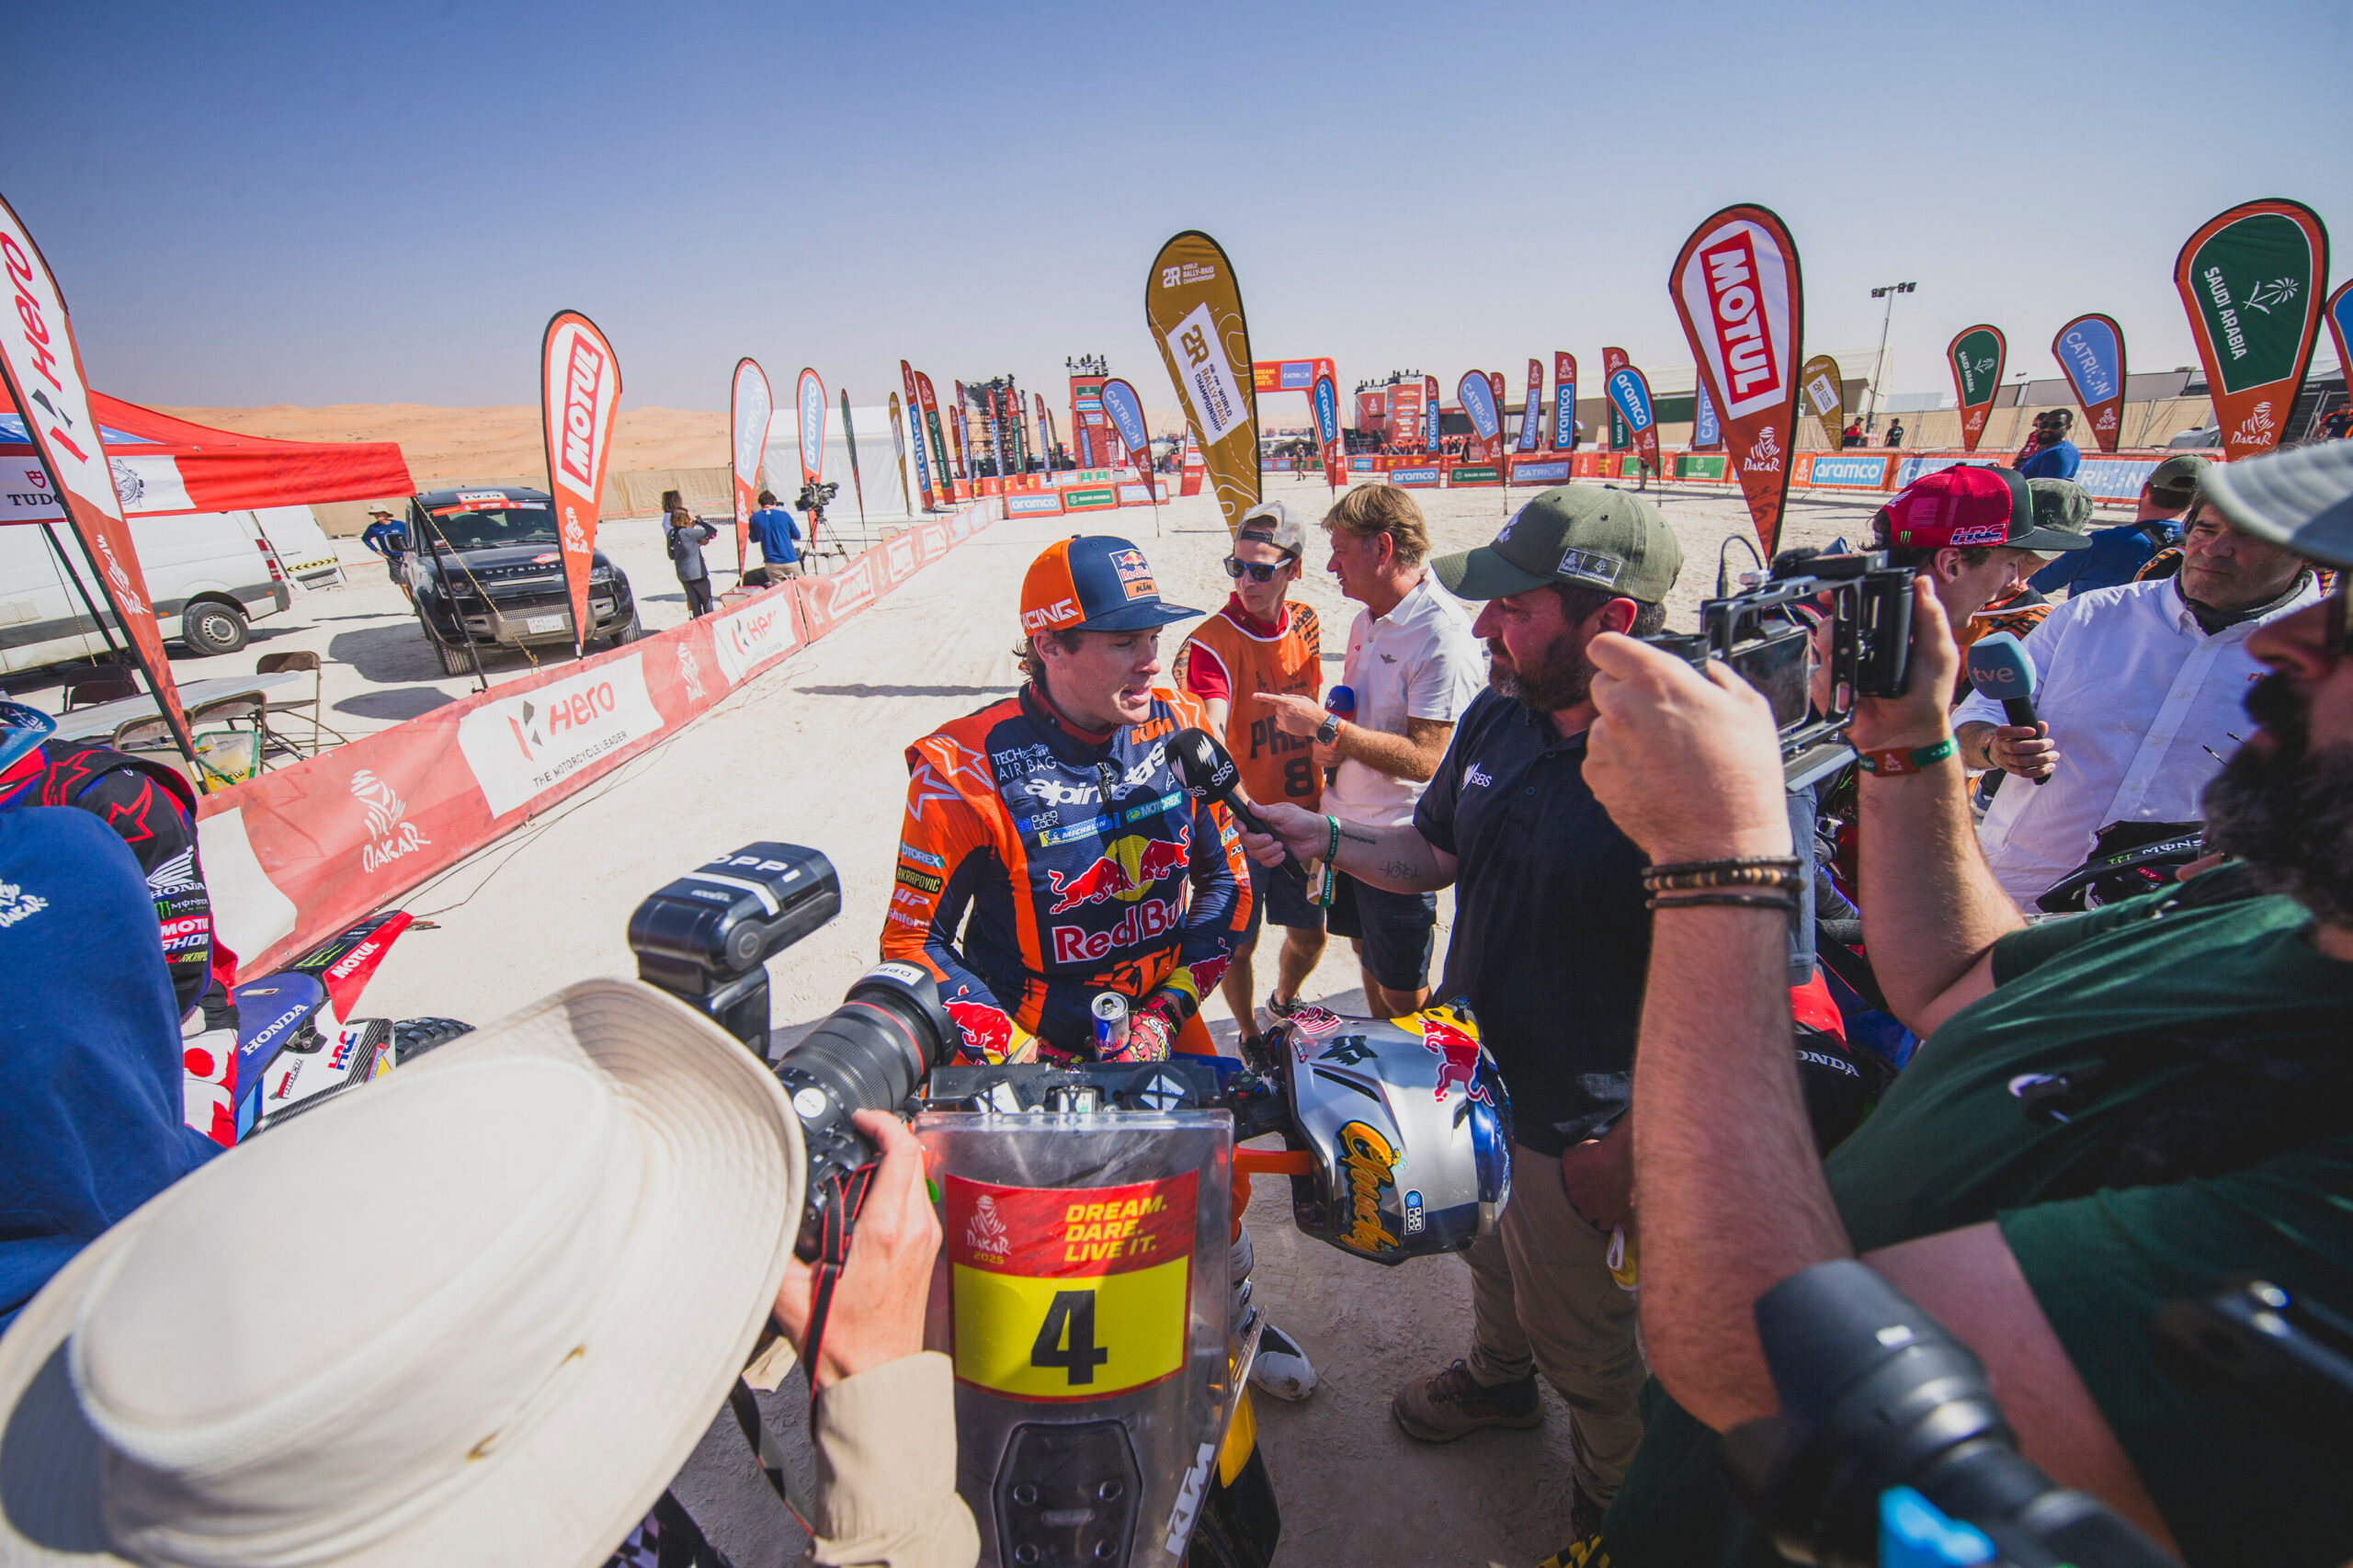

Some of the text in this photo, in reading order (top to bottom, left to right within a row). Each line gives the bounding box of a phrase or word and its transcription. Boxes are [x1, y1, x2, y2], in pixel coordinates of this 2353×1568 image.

[1183, 266, 1214, 278] RALLY-RAID
[1, 232, 62, 392] Hero
[1709, 248, 1769, 392] MOTUL
[2204, 267, 2248, 361] SAUDI ARABIA
[1959, 351, 1975, 393] SAUDI ARABIA
[2065, 332, 2112, 396] CATRION
[1195, 373, 1222, 432] CHAMPIONSHIP
[1201, 368, 1228, 426] RALLY-RAID
[1218, 388, 1233, 417] WORLD
[1320, 383, 1333, 438] aramco
[1463, 383, 1494, 432] CATRION
[1617, 374, 1647, 426] aramco
[565, 345, 599, 480] MOTUL
[806, 382, 817, 465] aramco
[1107, 390, 1141, 446] CATRION
[1526, 393, 1538, 444] CATRION
[1559, 389, 1571, 443] aramco
[1701, 386, 1715, 438] CATRI
[911, 411, 926, 486] aramco
[2231, 431, 2271, 446] DAKAR
[934, 433, 948, 483] SAUDI ARABIA
[1744, 457, 1780, 472] DAKAR
[1814, 461, 1881, 481] aramco
[1392, 470, 1436, 484] aramco
[1518, 467, 1564, 478] CATRION
[2078, 469, 2145, 490] TRION
[1012, 497, 1056, 510] aramco
[1950, 523, 2006, 541] HRC
[485, 563, 563, 574] DEFENDE
[1120, 566, 1139, 581] Red
[1136, 582, 1153, 593] KTM
[1972, 666, 2016, 683] tve
[550, 681, 614, 735] Hero
[1131, 718, 1175, 745] KTM
[533, 731, 629, 788] THE MOTORCYCLE LEADER
[992, 747, 1023, 770] TECH
[999, 756, 1057, 780] AIR BAG
[1211, 761, 1234, 787] SBS
[1284, 756, 1314, 797] 8
[1472, 772, 1493, 788] SBS
[1030, 810, 1057, 824] QUAD
[1141, 794, 1182, 816] MOTOREX
[1033, 818, 1060, 830] LOCK
[1062, 820, 1107, 839] MICHELIN
[362, 822, 432, 873] DAKAR
[901, 841, 942, 869] OTOREX
[2143, 839, 2203, 855] MONS
[161, 918, 209, 937] MOTU
[1051, 878, 1188, 965] Red Bull
[162, 934, 209, 950] SHO
[331, 941, 381, 979] MOTUL
[240, 1004, 309, 1056] HONDA
[328, 1030, 358, 1071] HRC
[1064, 1195, 1167, 1222] DREAM.
[966, 1229, 1011, 1256] DAKAR
[1064, 1219, 1142, 1242] DARE.
[973, 1251, 1004, 1265] 2025
[1064, 1234, 1156, 1262] LIVE IT.
[1030, 1290, 1108, 1386] 4
[1165, 1443, 1216, 1557] KTM
